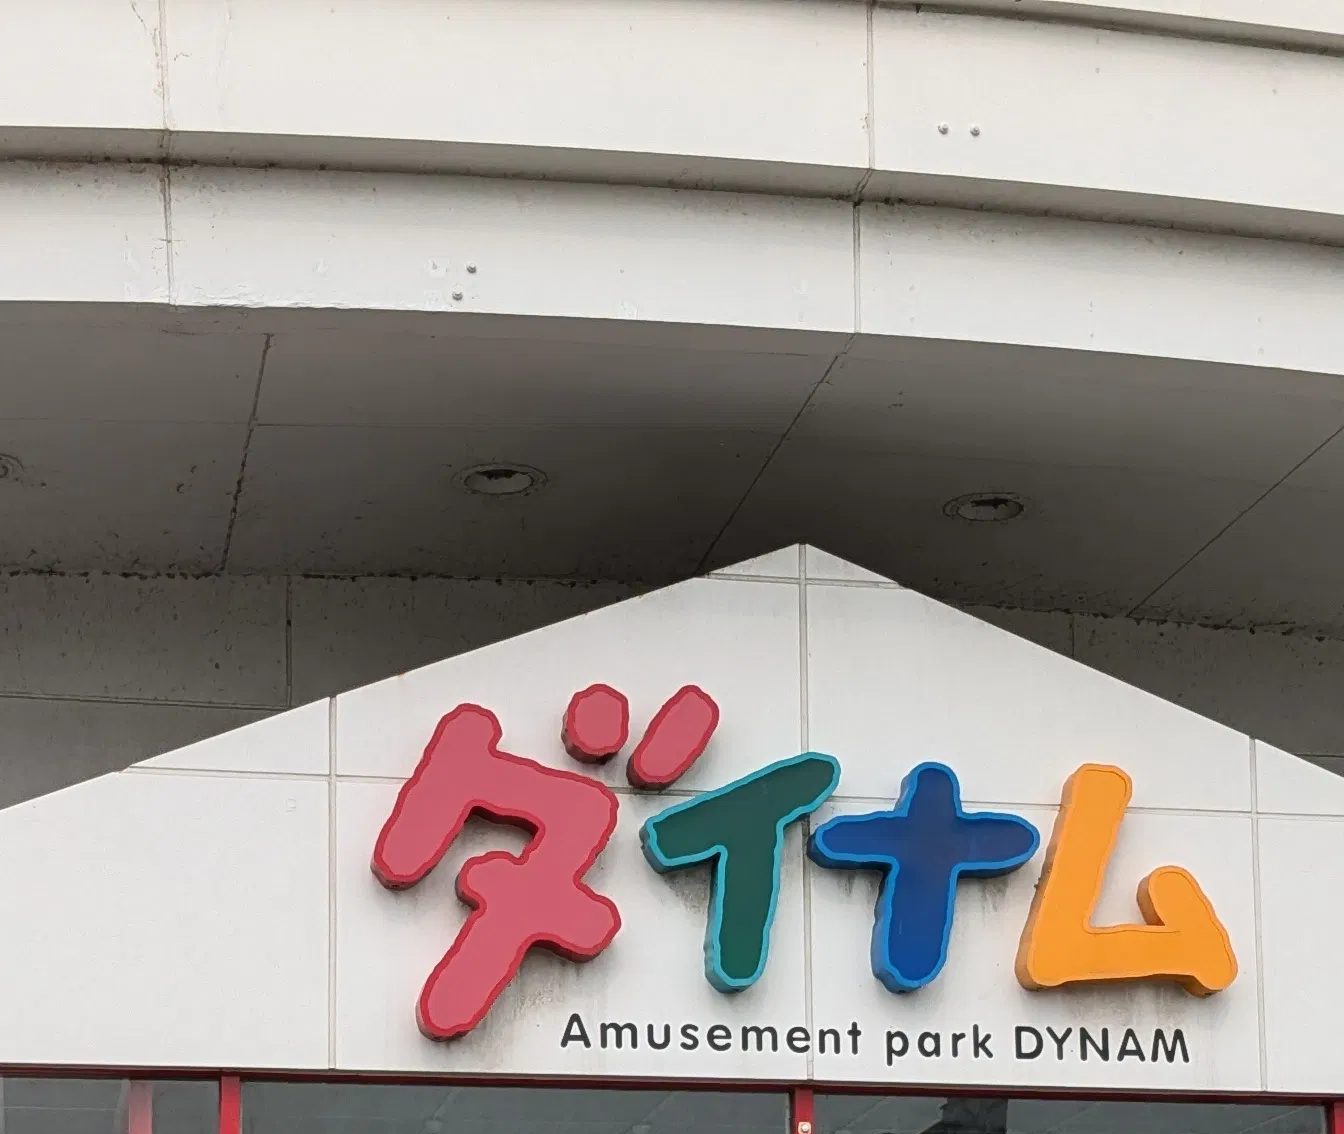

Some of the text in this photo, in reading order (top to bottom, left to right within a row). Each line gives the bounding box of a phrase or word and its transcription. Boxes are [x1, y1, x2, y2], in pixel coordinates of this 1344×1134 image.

[370, 683, 1239, 1042] ダイナム
[559, 1012, 1191, 1067] Amusement park DYNAM
